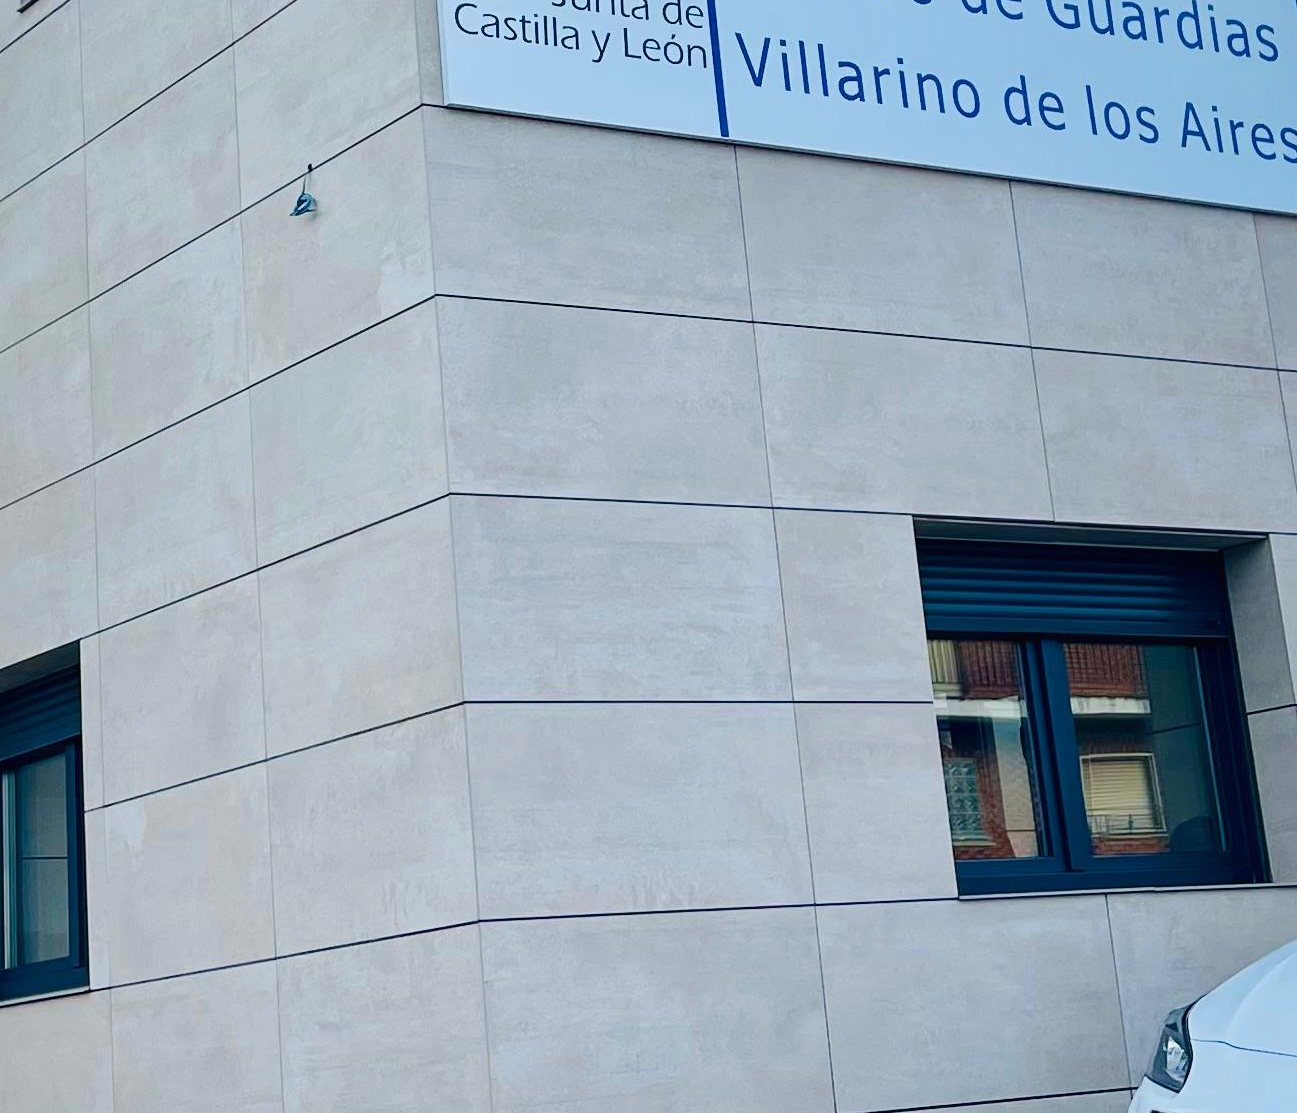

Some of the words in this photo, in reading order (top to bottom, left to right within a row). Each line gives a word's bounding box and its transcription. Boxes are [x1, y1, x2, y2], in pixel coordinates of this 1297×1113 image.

[454, 2, 580, 51] Castilla
[591, 29, 611, 64] y
[622, 27, 708, 69] León
[734, 31, 981, 119] Villarino
[1003, 74, 1067, 131] de
[1085, 84, 1160, 145] los
